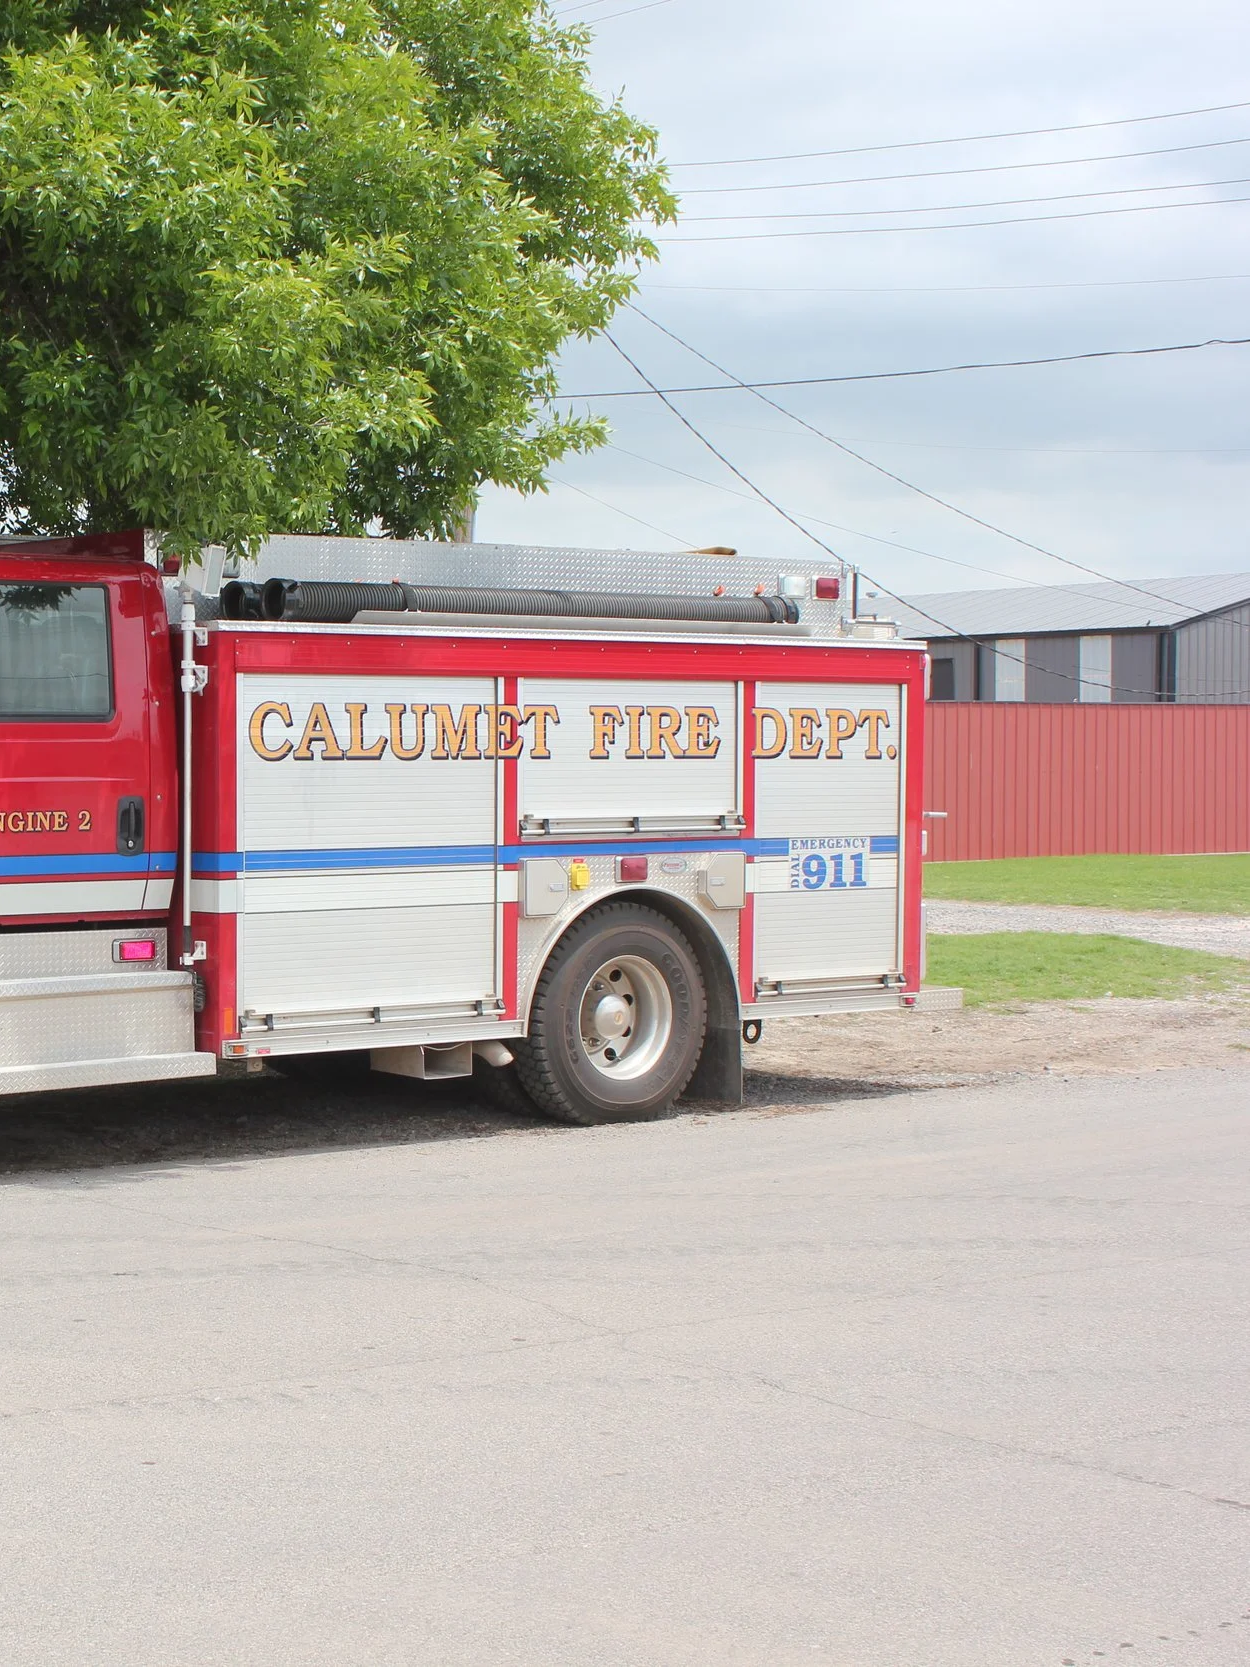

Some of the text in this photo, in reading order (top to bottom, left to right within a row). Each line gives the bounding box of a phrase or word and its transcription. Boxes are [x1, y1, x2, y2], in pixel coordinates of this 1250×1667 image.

[249, 700, 898, 761] CALUMET FIRE DEPT.
[78, 810, 92, 831] 2
[791, 838, 867, 850] EMERGENCY
[790, 853, 801, 889] DIAL
[802, 852, 867, 890] 911
